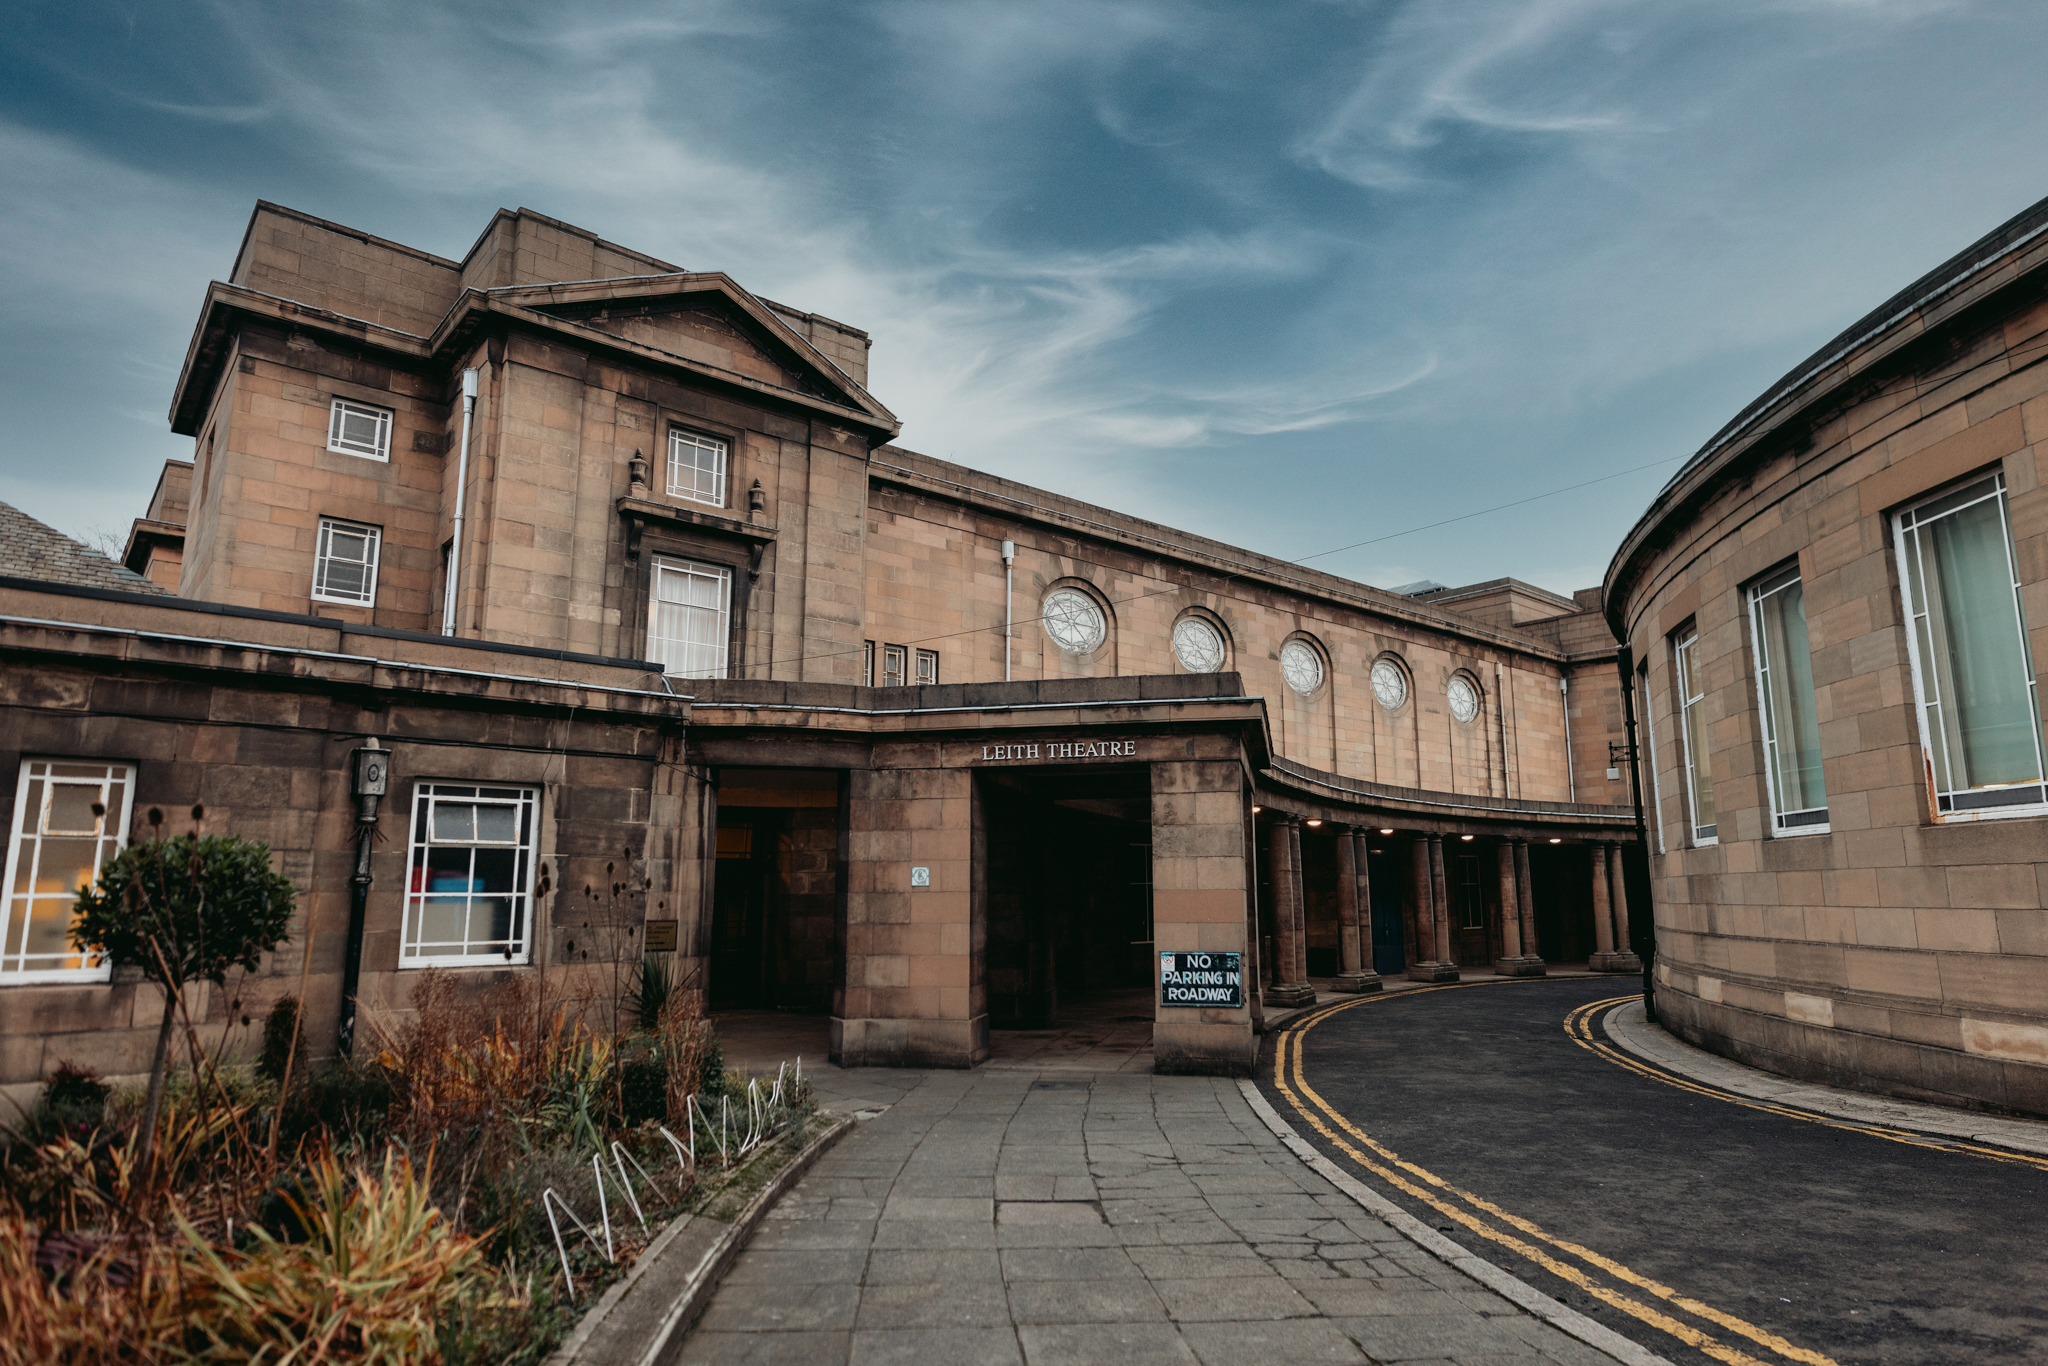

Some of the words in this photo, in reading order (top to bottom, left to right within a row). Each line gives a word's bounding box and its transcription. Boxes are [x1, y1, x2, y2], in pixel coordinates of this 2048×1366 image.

[982, 744, 1039, 761] LEITH
[1046, 741, 1136, 758] THEATRE
[1187, 955, 1212, 969] NO
[1163, 971, 1223, 985] PARKING
[1226, 972, 1239, 985] IN
[1168, 987, 1233, 1001] ROADWAY
